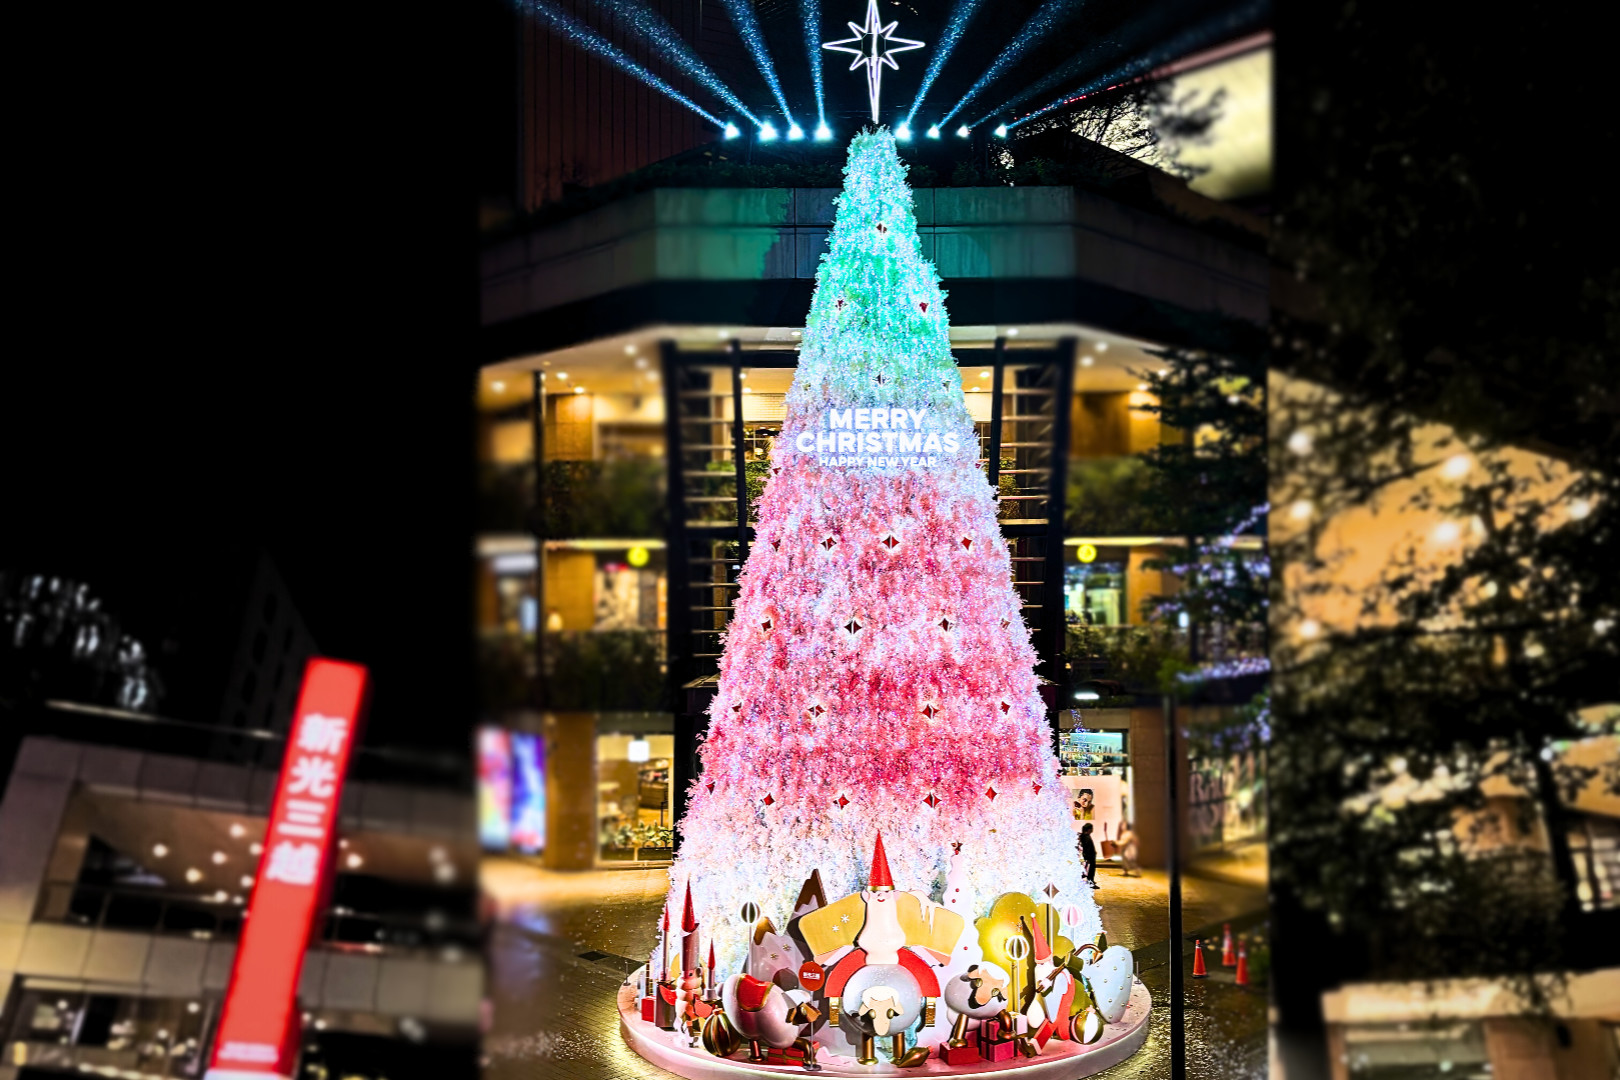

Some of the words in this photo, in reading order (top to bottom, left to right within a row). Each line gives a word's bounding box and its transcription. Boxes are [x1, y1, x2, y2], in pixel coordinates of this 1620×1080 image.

[829, 408, 927, 430] MERRY
[795, 432, 961, 453] CHRISTMAS
[819, 456, 864, 467] HAPPY
[867, 456, 902, 467] NEW
[902, 456, 937, 467] YEAR
[266, 713, 346, 885] 新光三越
